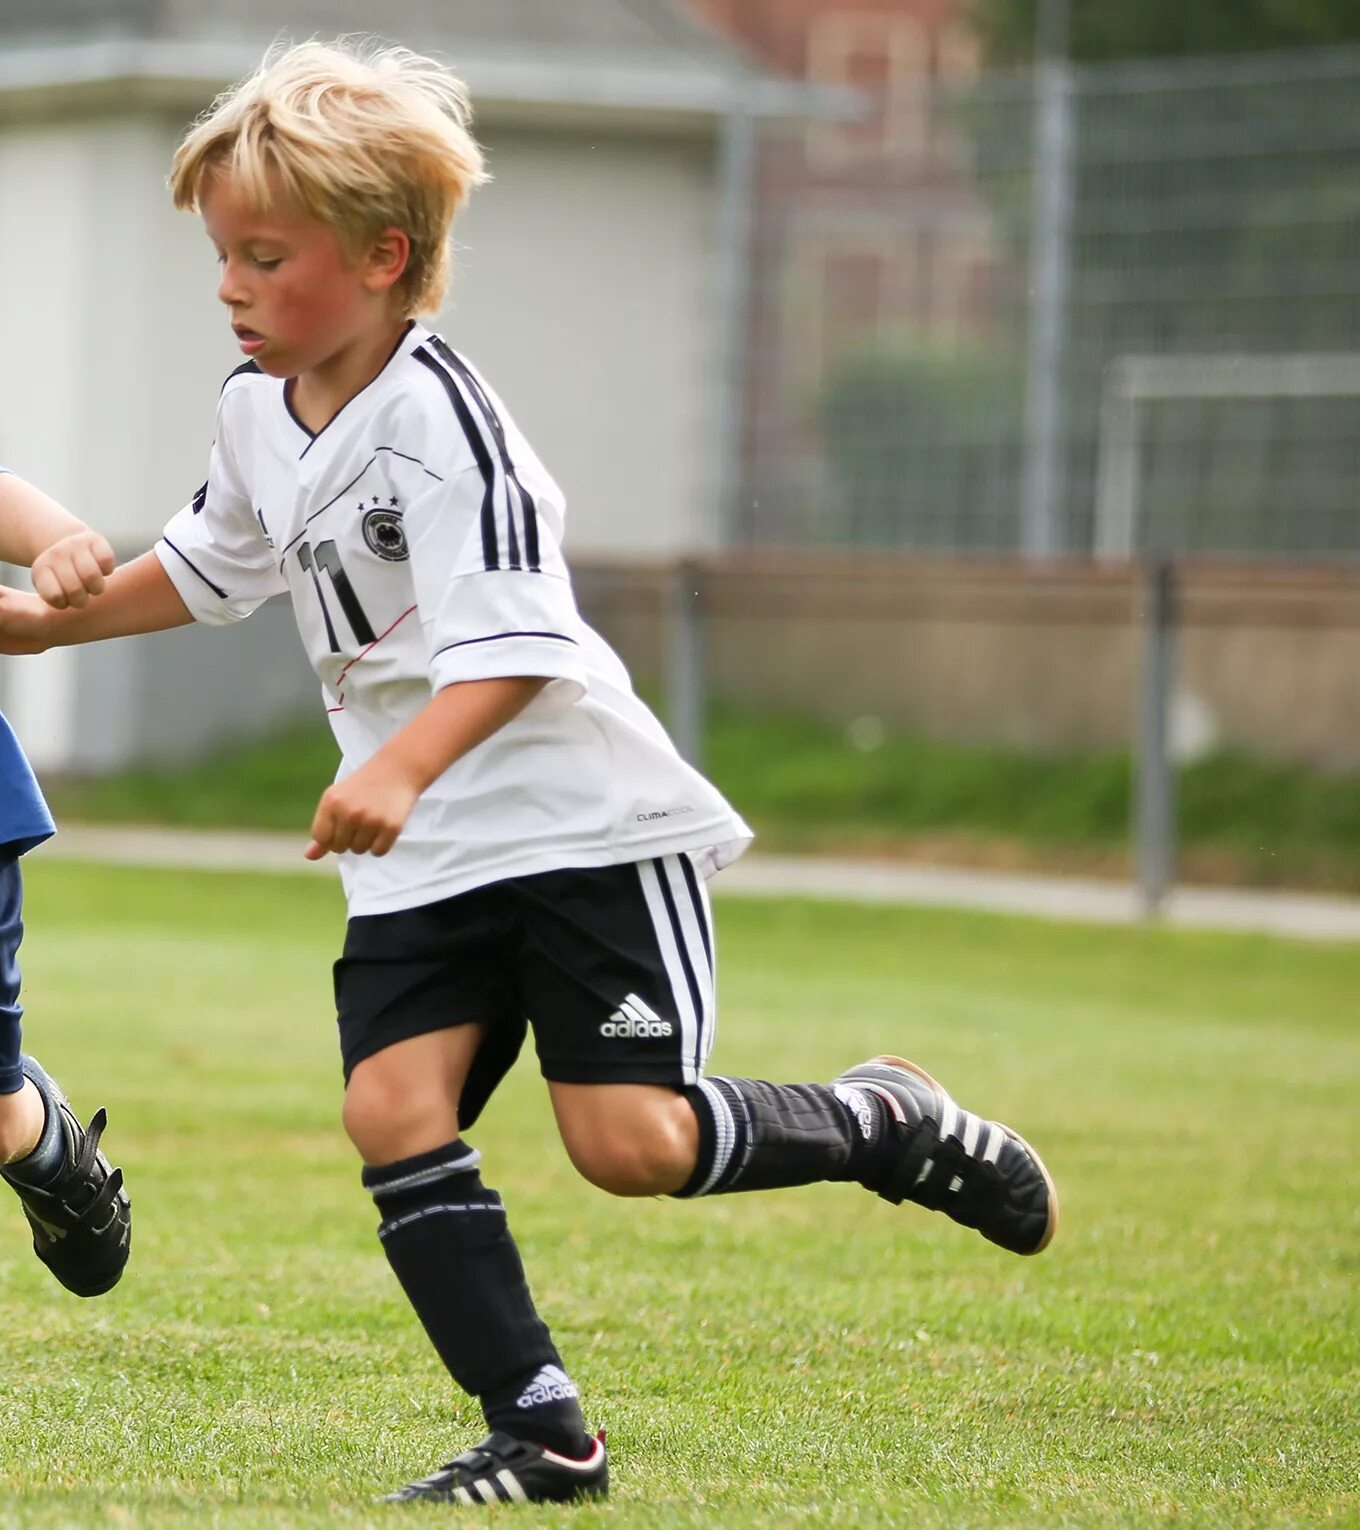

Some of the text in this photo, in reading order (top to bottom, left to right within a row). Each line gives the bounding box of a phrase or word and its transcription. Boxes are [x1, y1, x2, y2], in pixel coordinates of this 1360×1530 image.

[297, 539, 378, 653] 11
[600, 1020, 673, 1038] adidas
[517, 1383, 578, 1408] adida
